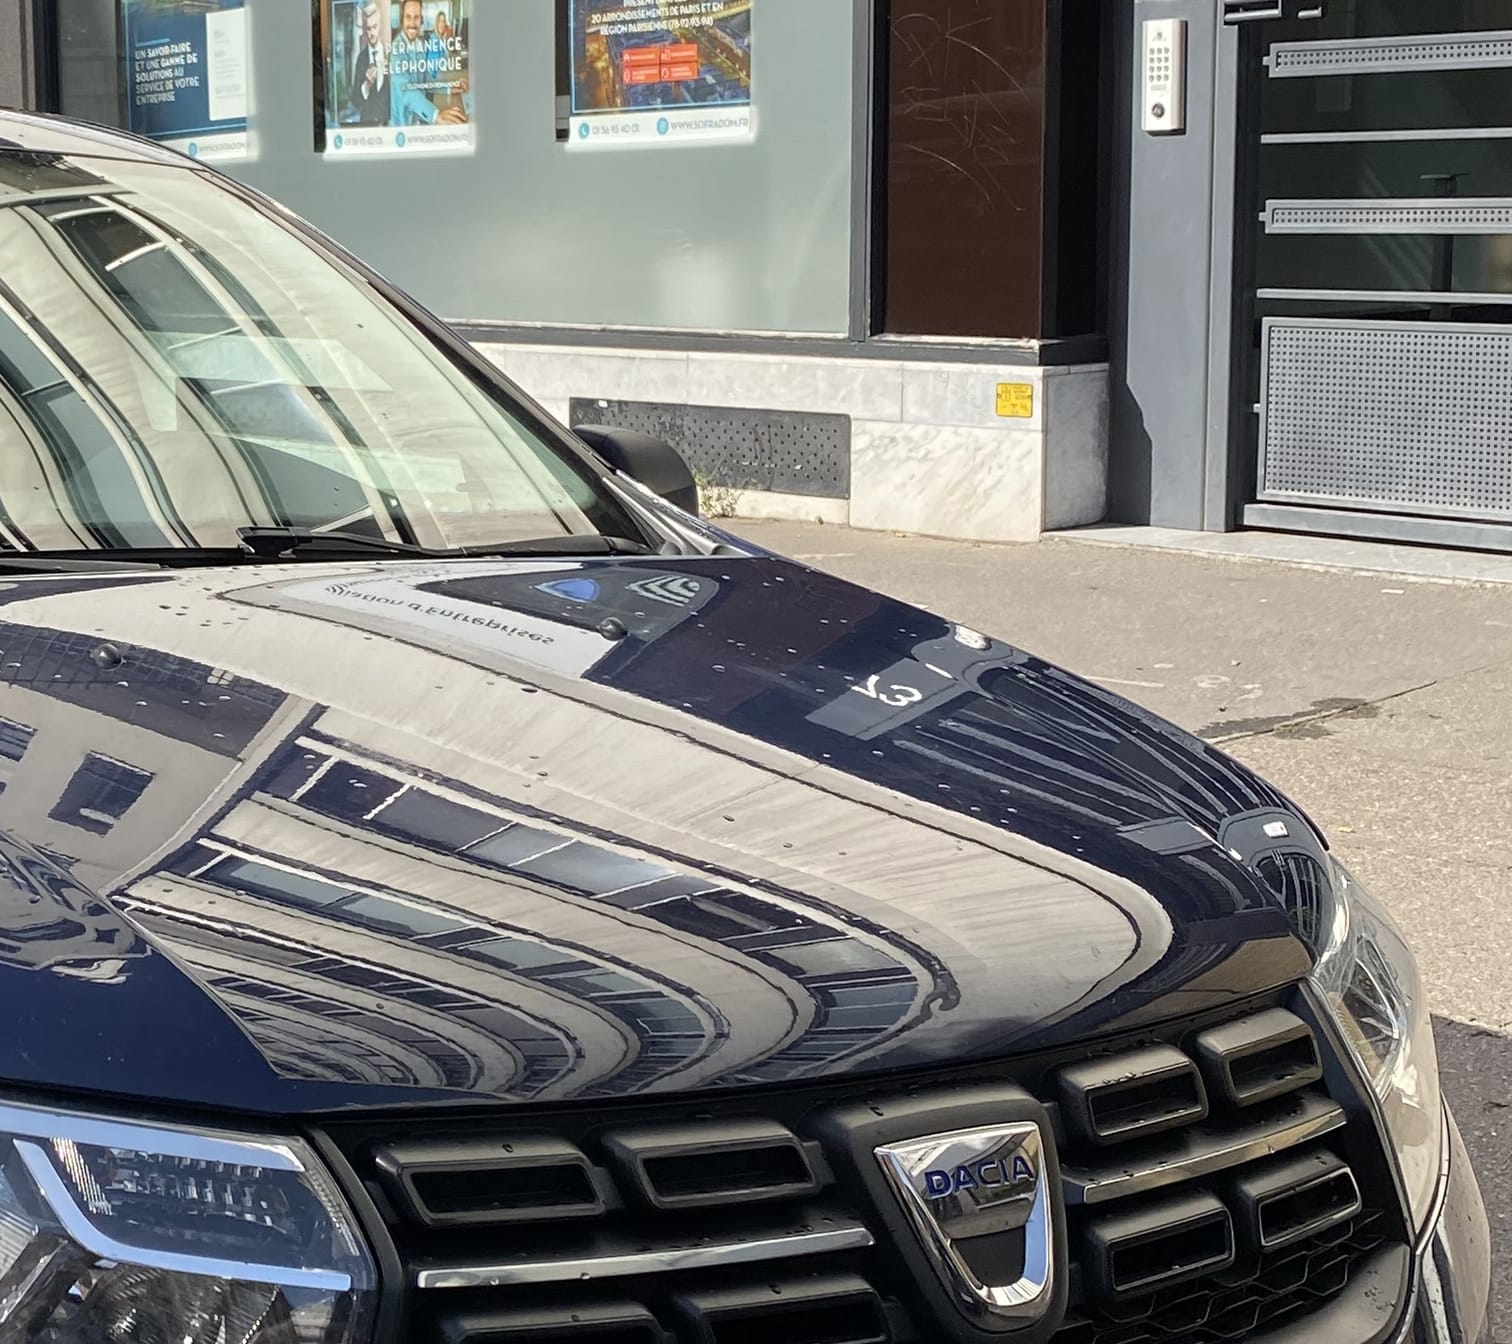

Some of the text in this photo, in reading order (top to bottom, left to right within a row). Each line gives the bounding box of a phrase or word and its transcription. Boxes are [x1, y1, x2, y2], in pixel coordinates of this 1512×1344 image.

[591, 13, 603, 25] 20
[670, 5, 680, 17] DE
[701, 2, 711, 13] ET
[135, 49, 147, 61] UN
[385, 36, 463, 56] PERMANENCE
[135, 60, 145, 72] ET
[186, 52, 199, 65] DE
[135, 80, 165, 95] SERVICE
[175, 76, 200, 89] VOTRE
[925, 1153, 1039, 1199] DACIA
